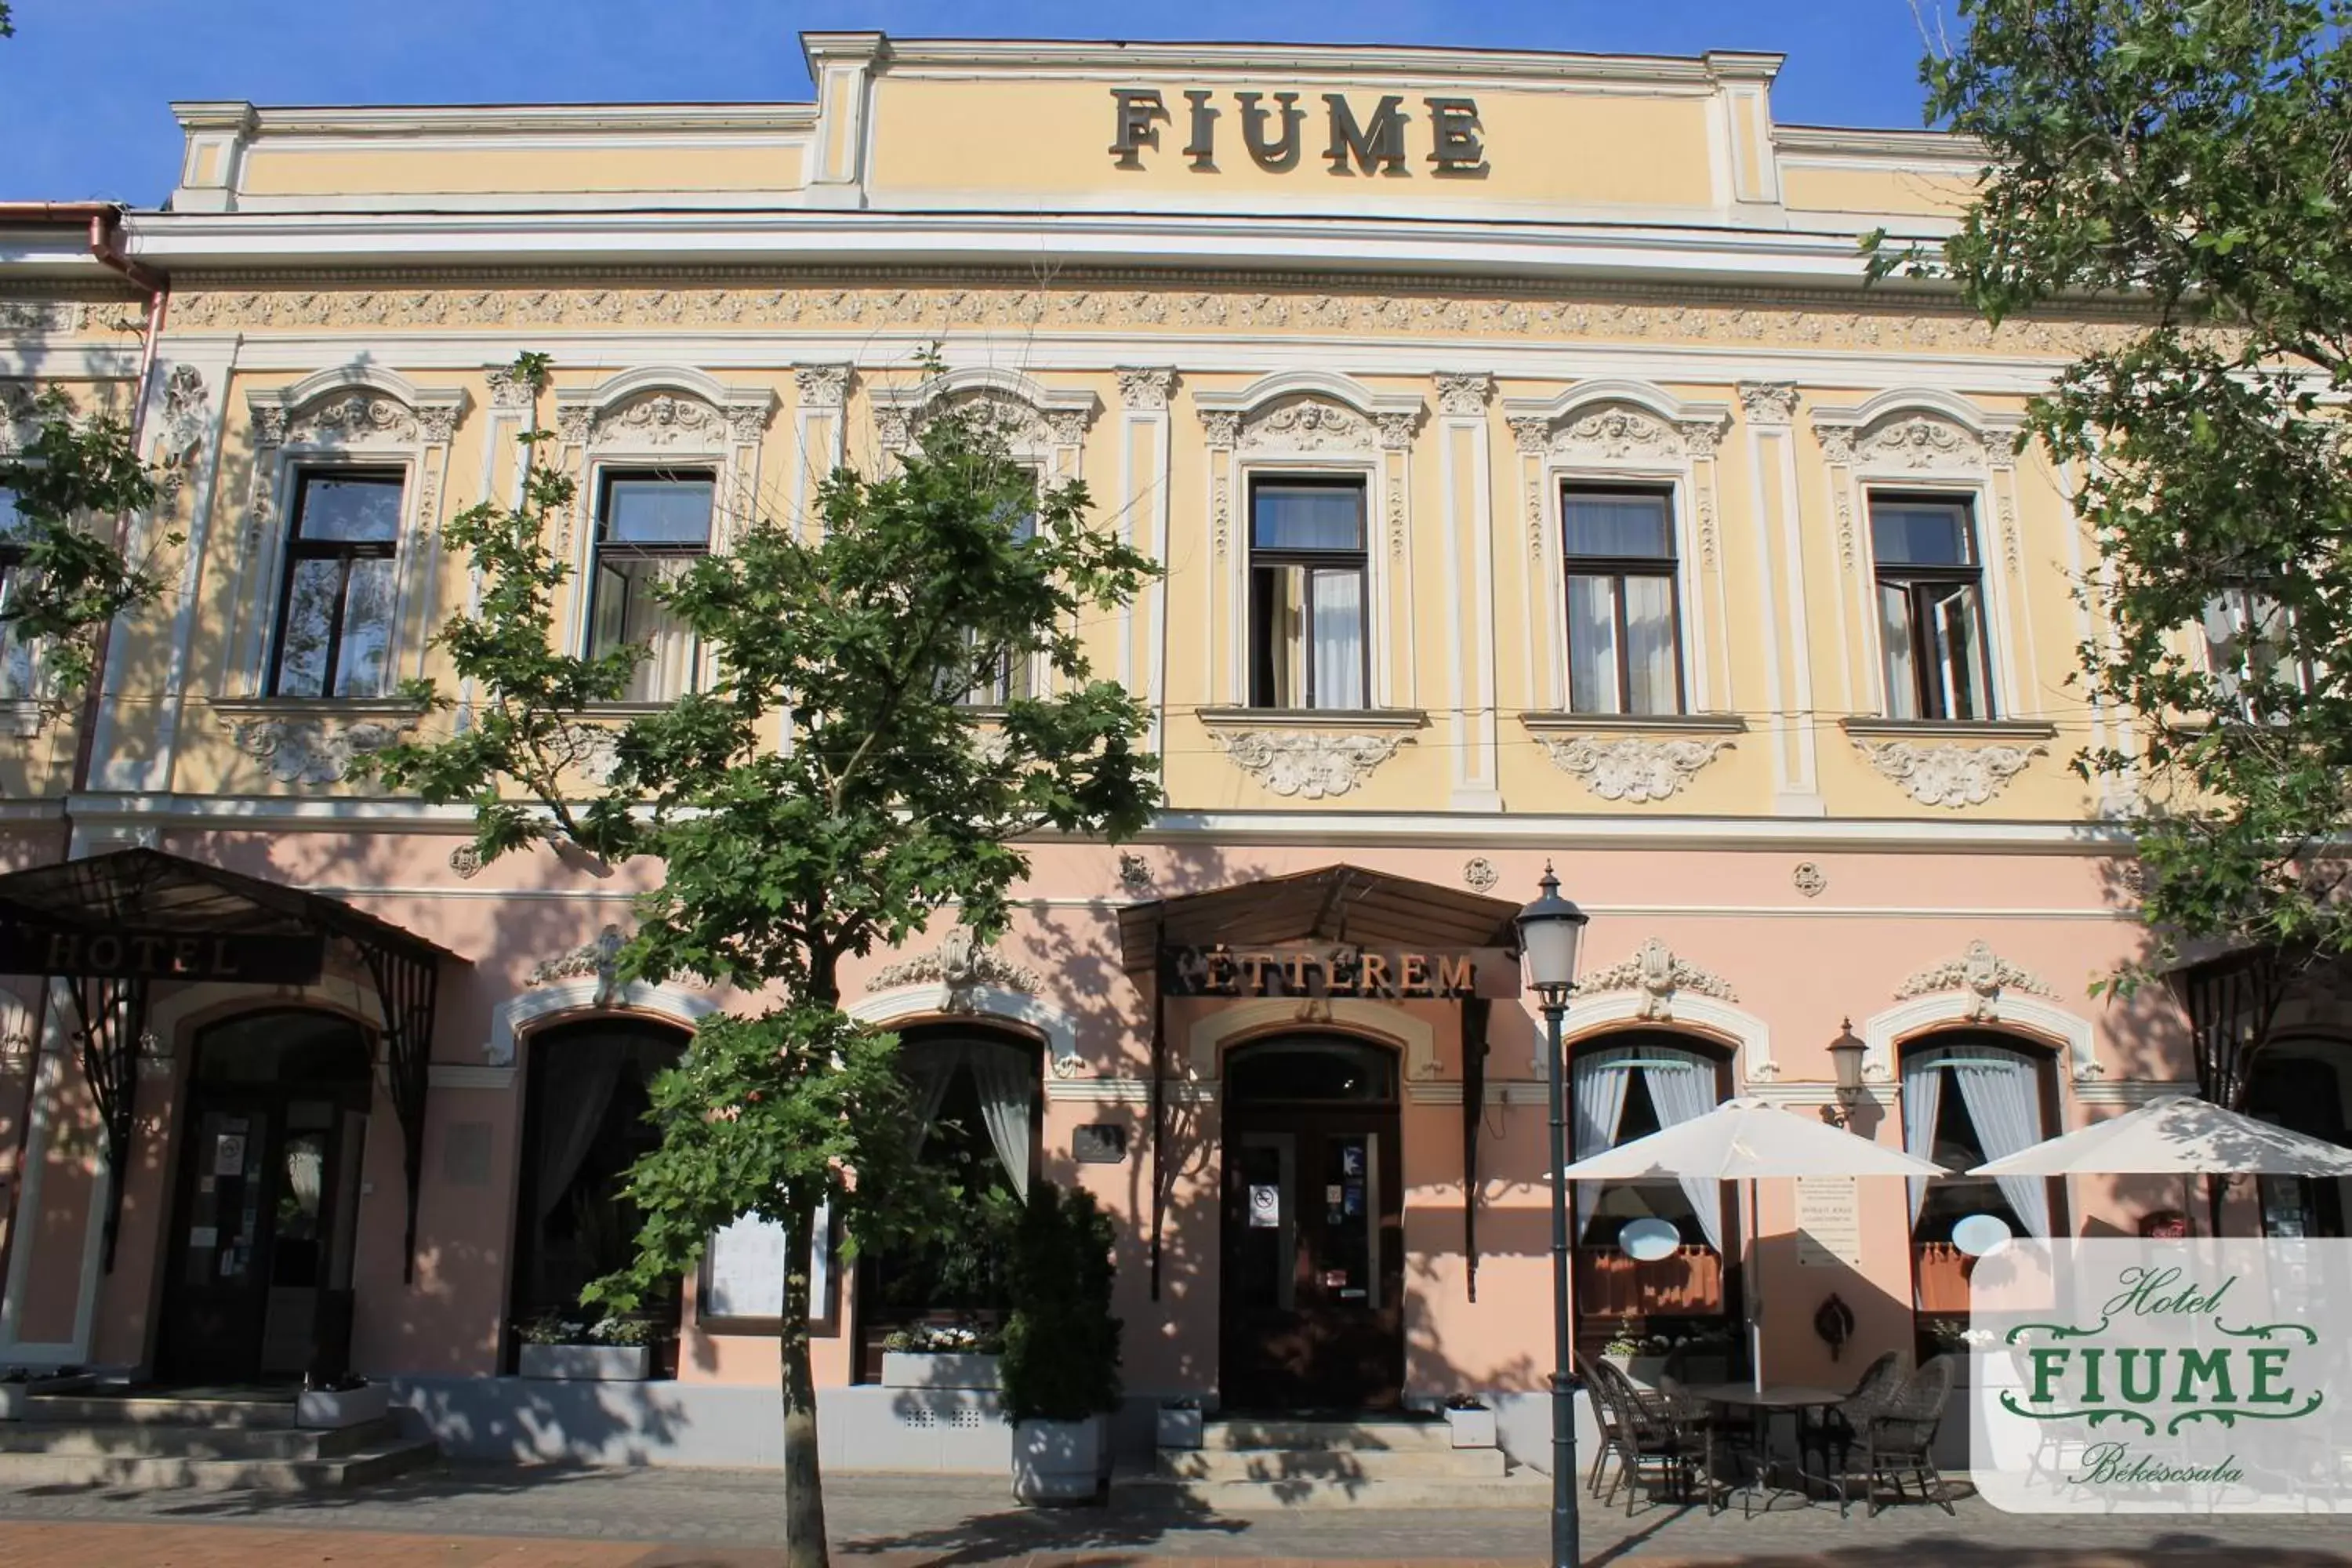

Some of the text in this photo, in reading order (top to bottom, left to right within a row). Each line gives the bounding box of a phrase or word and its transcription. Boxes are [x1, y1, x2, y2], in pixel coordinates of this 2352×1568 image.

[1108, 87, 1486, 169] FIUME
[46, 931, 240, 975] HOTEL
[1204, 943, 1474, 990] ÉTTEREM
